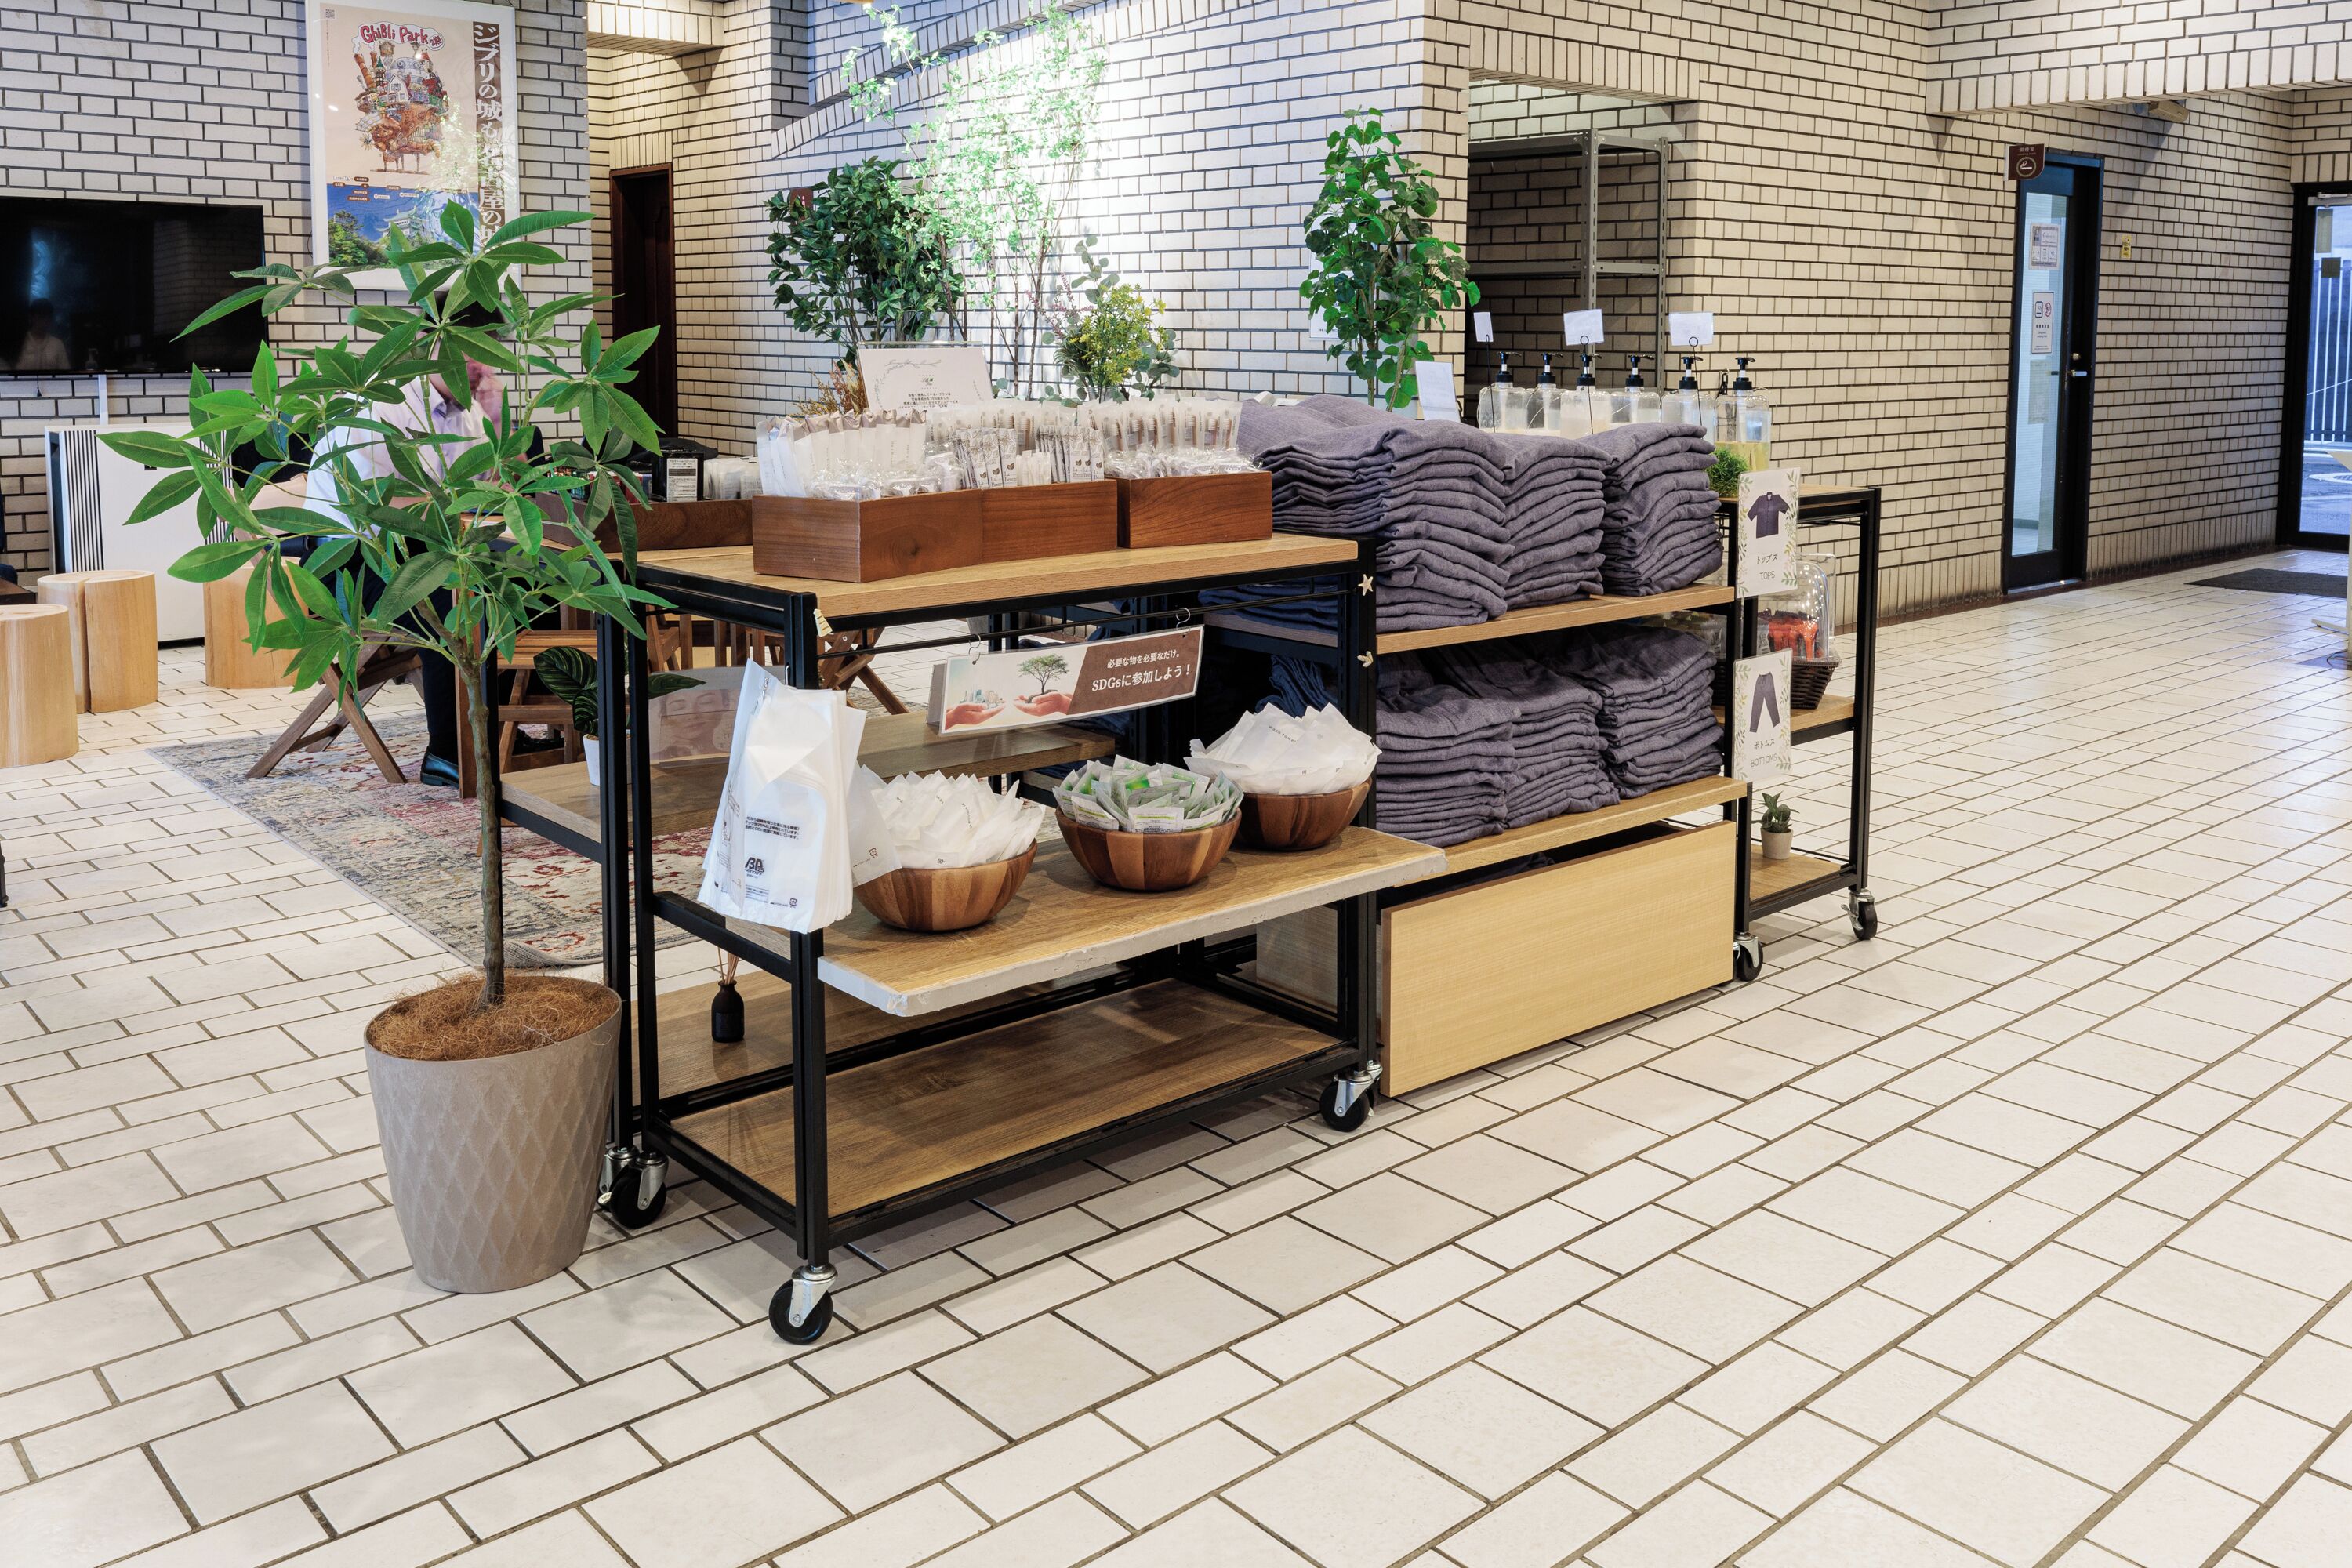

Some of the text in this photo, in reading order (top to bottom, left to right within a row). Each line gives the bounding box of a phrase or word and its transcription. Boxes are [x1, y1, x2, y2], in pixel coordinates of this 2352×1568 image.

[399, 26, 429, 44] Park
[1757, 554, 1777, 564] トップス
[1759, 570, 1776, 580] TOPS
[1107, 649, 1179, 669] 必要な物を必要なだけ。
[1754, 739, 1775, 750] ボトムス
[1751, 753, 1777, 768] BOTTOMS
